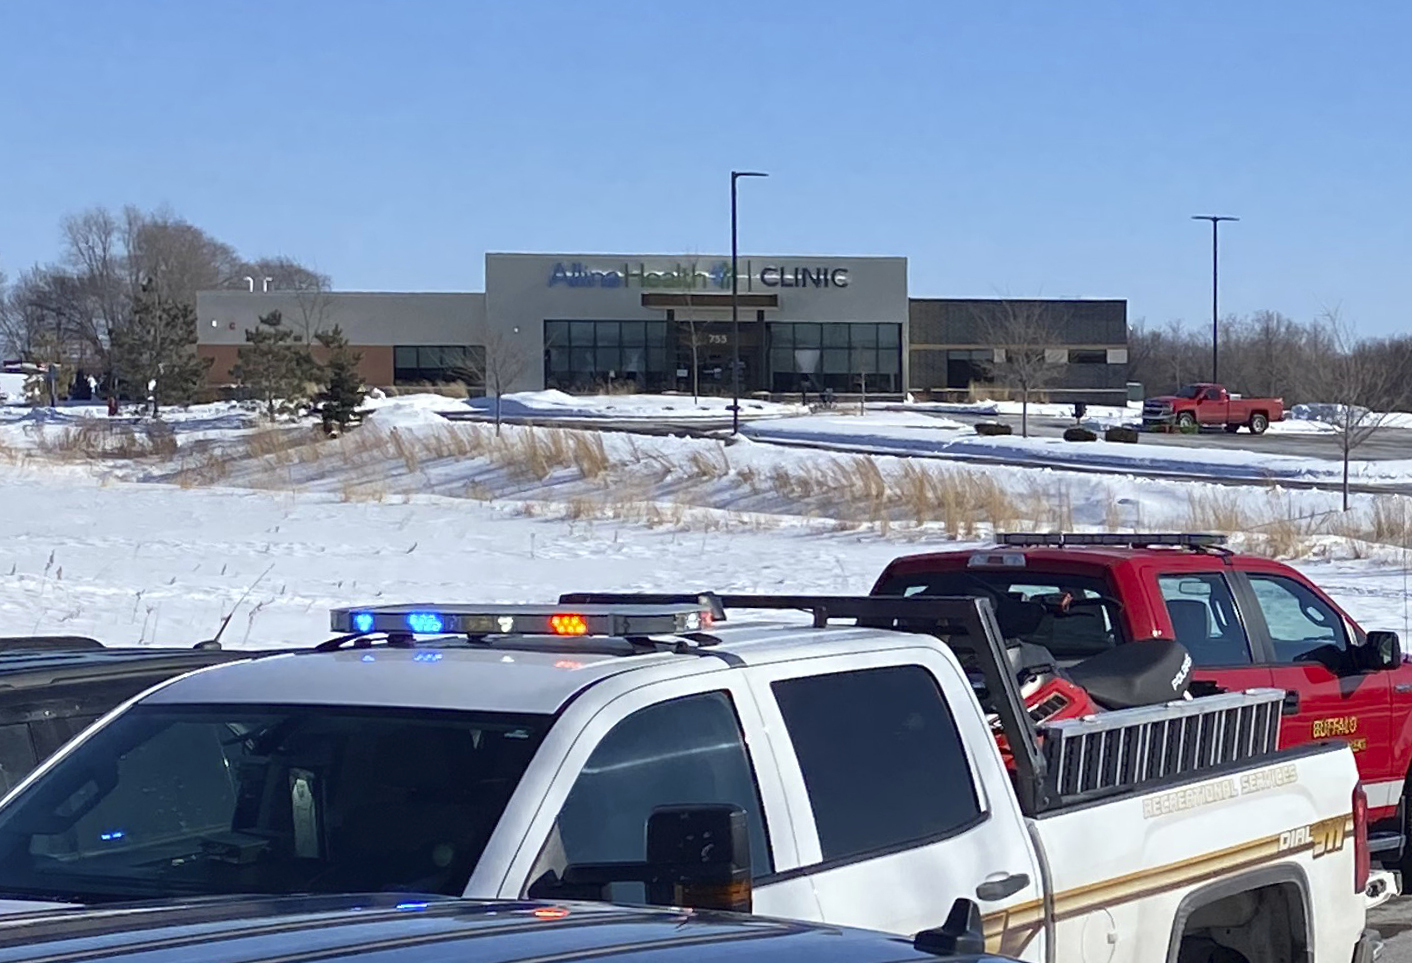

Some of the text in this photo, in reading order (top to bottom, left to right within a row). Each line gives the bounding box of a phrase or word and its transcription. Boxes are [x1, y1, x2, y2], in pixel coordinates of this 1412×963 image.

[760, 266, 849, 288] CLINIC
[1313, 715, 1357, 739] BUFFALO
[1142, 764, 1298, 820] RECREATIONAL SERVICES
[1279, 825, 1314, 851] DIAL
